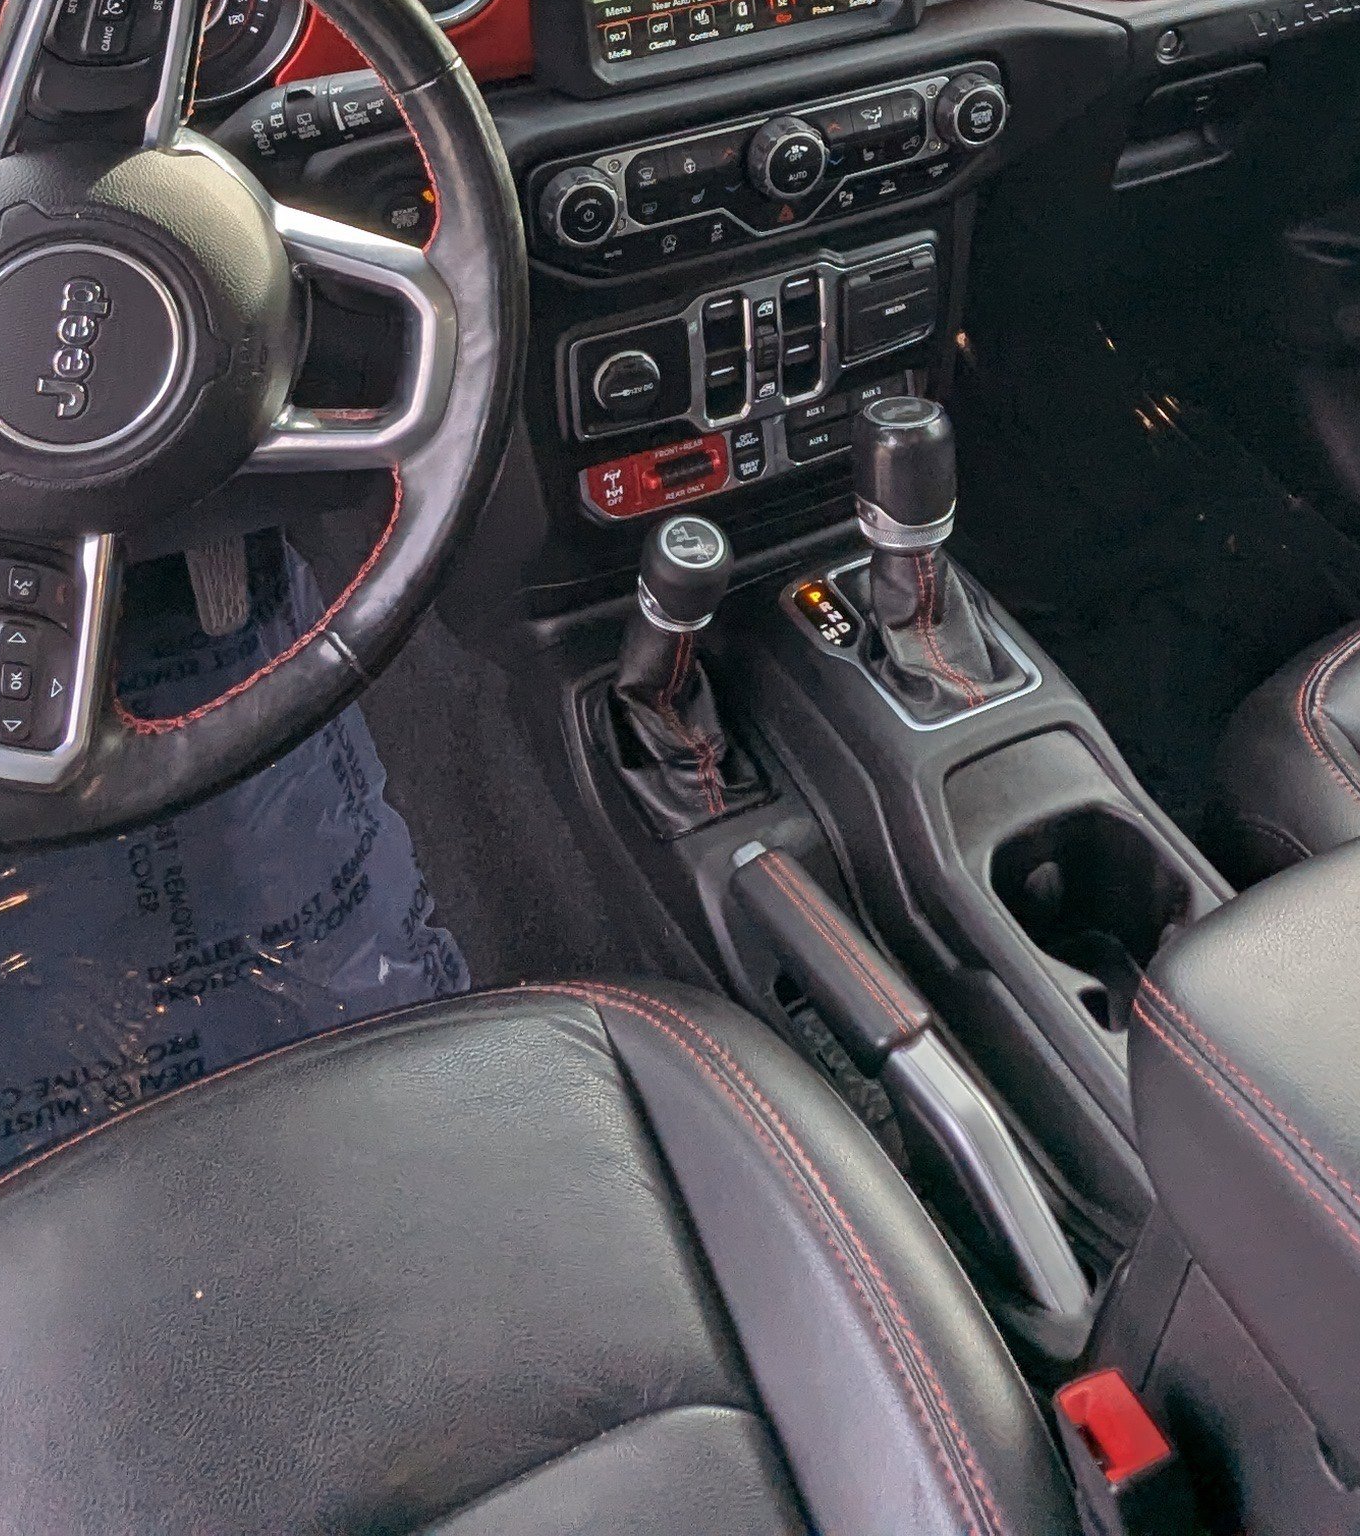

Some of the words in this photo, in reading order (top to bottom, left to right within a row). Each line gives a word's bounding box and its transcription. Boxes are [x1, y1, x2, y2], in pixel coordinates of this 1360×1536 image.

[605, 5, 632, 18] Menu
[228, 13, 245, 26] 120
[609, 31, 627, 43] 90.7
[788, 170, 808, 182] AUTO
[36, 276, 110, 419] Jeep
[809, 591, 821, 603] P
[819, 601, 833, 613] R
[827, 610, 843, 623] N
[822, 627, 840, 641] M
[836, 622, 851, 634] D
[10, 671, 23, 690] OK
